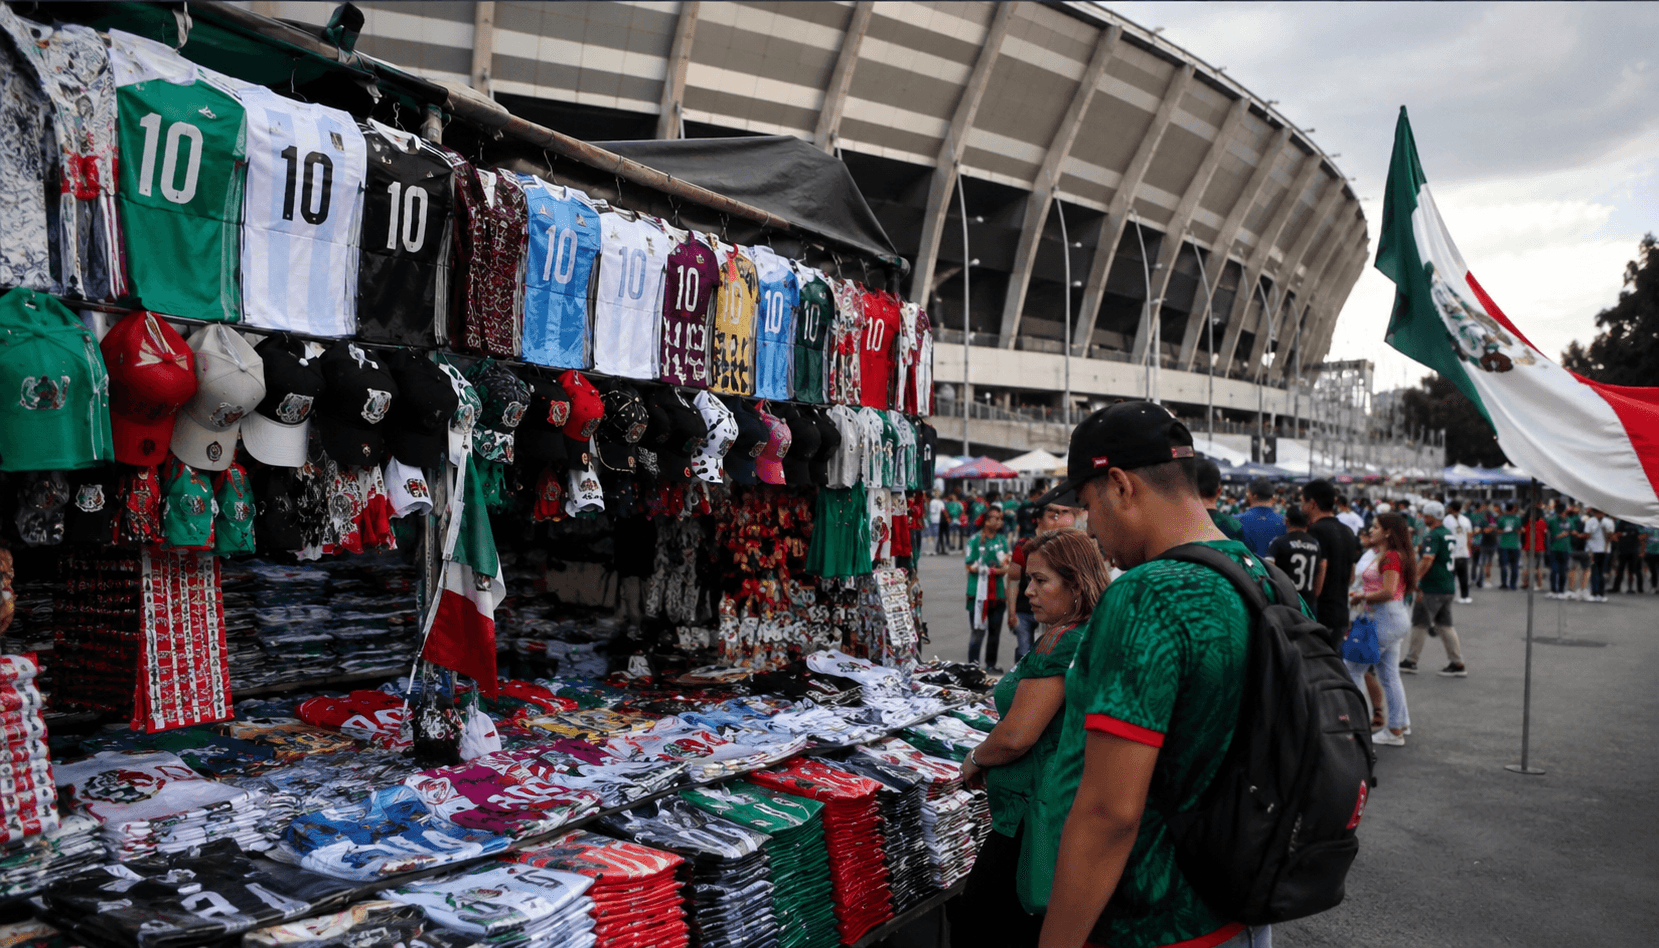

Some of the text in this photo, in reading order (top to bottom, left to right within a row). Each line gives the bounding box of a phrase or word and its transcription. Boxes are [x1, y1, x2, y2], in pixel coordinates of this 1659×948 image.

[139, 112, 204, 204] 10
[281, 145, 333, 225] 10
[387, 181, 428, 253] 10
[542, 224, 578, 285] 10
[618, 246, 647, 300] 10
[676, 264, 700, 312] 10
[723, 280, 743, 325] 10
[764, 289, 784, 334] 10
[804, 300, 820, 342] 10
[866, 316, 885, 352] 10
[1290, 553, 1317, 591] 31
